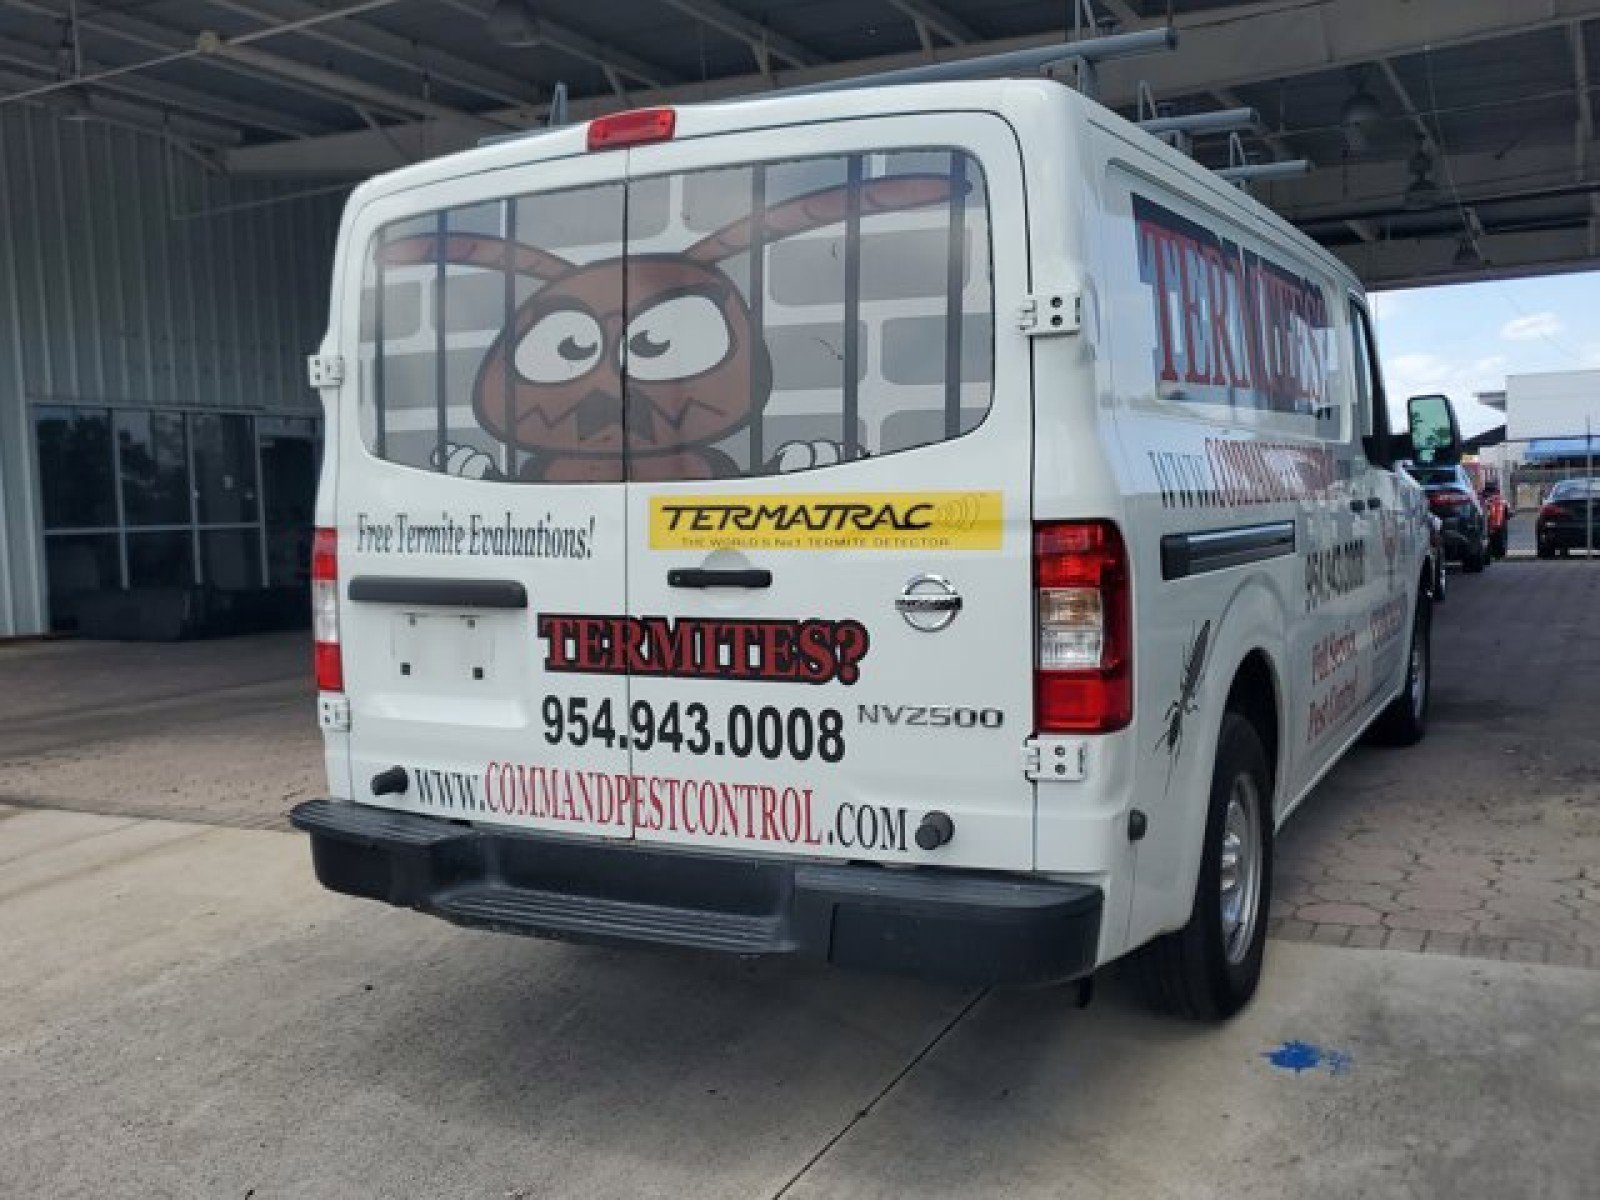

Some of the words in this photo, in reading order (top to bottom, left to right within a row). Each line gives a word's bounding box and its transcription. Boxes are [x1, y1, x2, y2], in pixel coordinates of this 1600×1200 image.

[357, 512, 393, 553] Free
[396, 511, 465, 555] Termite
[469, 511, 596, 560] Evaluations!
[662, 504, 934, 531] TERMATRAC
[537, 612, 870, 685] TERMITES?
[542, 695, 846, 763] 954.943.0008
[857, 704, 1004, 728] NV2500
